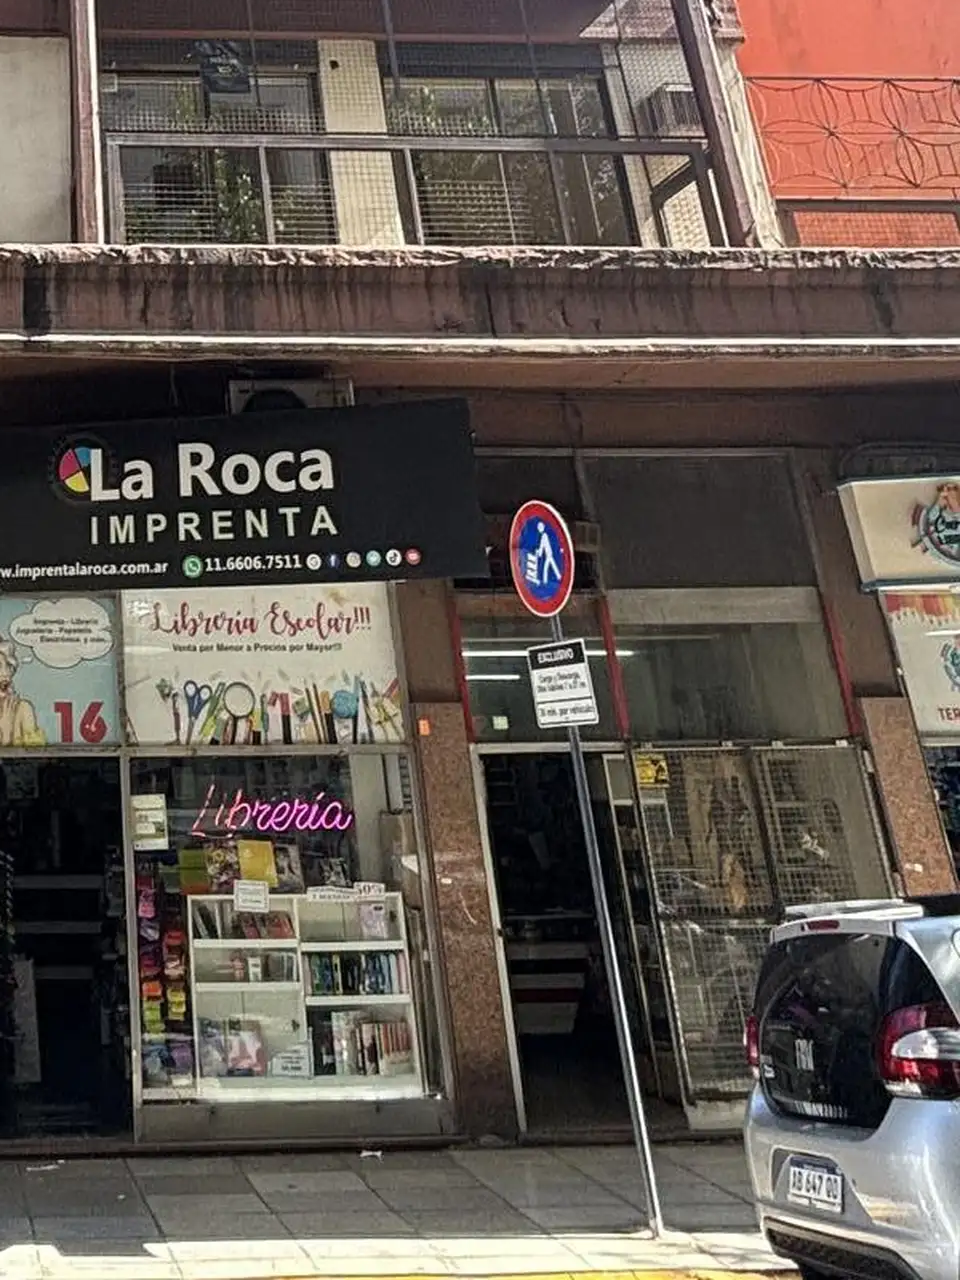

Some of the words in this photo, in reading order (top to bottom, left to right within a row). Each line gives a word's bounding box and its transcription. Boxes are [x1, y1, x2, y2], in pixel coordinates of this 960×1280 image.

[90, 448, 154, 502] La
[178, 441, 336, 498] Roca
[90, 505, 339, 545] IMPRENTA
[204, 553, 303, 573] 11.6606.7511
[264, 600, 372, 641] Escolar!!!
[172, 643, 197, 653] Venta
[199, 643, 214, 653] por
[216, 643, 243, 653] Menor
[254, 643, 287, 653] Precios
[289, 643, 304, 653] por
[54, 700, 109, 744] 16
[191, 784, 353, 839] Librería
